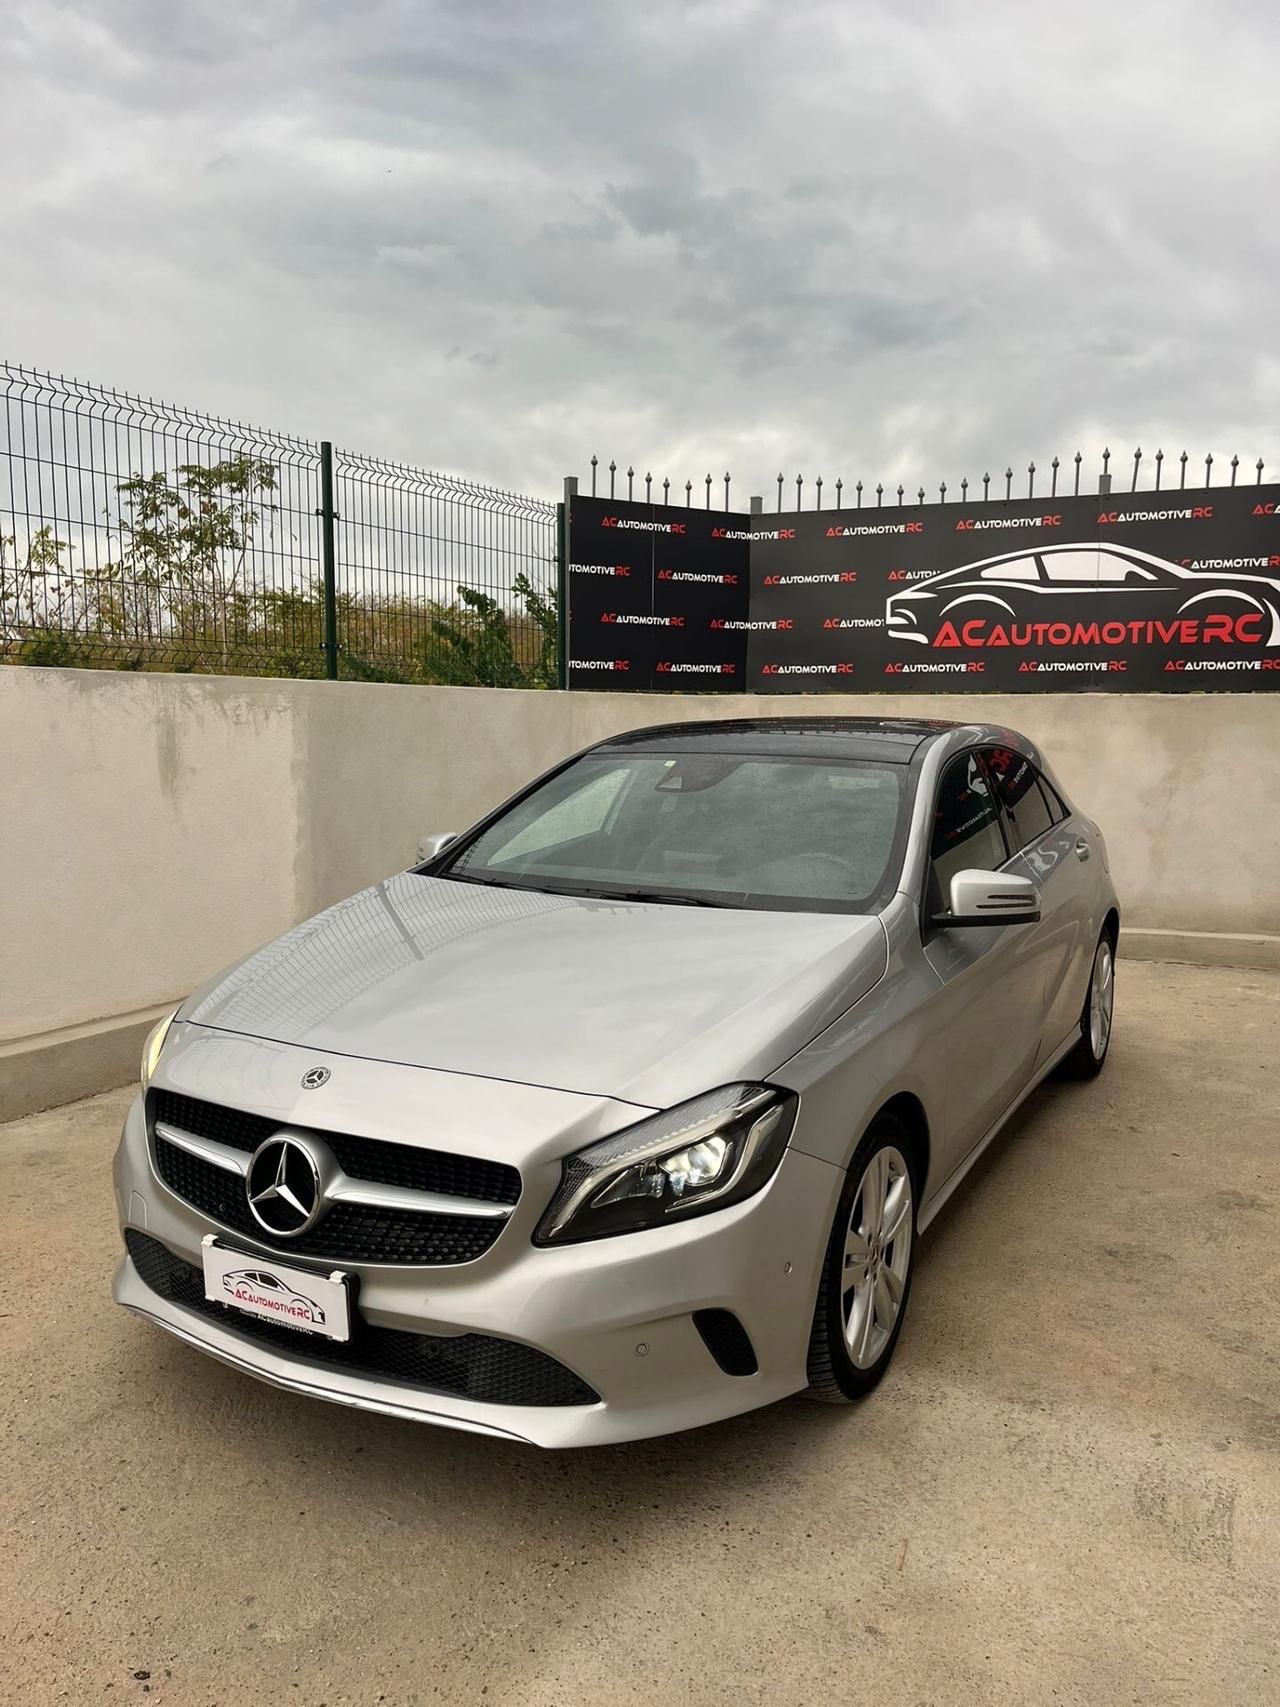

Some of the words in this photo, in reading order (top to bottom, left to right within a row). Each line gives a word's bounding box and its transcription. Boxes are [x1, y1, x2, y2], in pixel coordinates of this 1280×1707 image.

[955, 514, 1062, 530] ACAUTOMOTIVERC
[1096, 506, 1213, 524] ACAUTOMOTIVERC
[601, 516, 686, 534] ACAUTOMOTIVERC
[825, 522, 923, 537] ACAUTOMOTIVERC
[711, 528, 797, 541] ACAUTOMOTIVERC
[656, 569, 738, 584] ACAUTOMOTIVERC
[764, 572, 857, 585] ACAUTOMOTIVERC
[600, 612, 685, 627] ACAUTOMOTIVERC
[710, 619, 794, 630] ACAUTOMOTIVERC
[932, 613, 1264, 647] ACAUTOMOTIVERC
[656, 662, 736, 674] ACAUTOMOTIVERC
[761, 664, 854, 674] ACAUTOMOTIVERC
[884, 662, 985, 673] ACAUTOMOTIVERC
[1018, 661, 1127, 672] ACAUTOMOTIVERC
[234, 1289, 310, 1320] ACAUTOMOTIVERC
